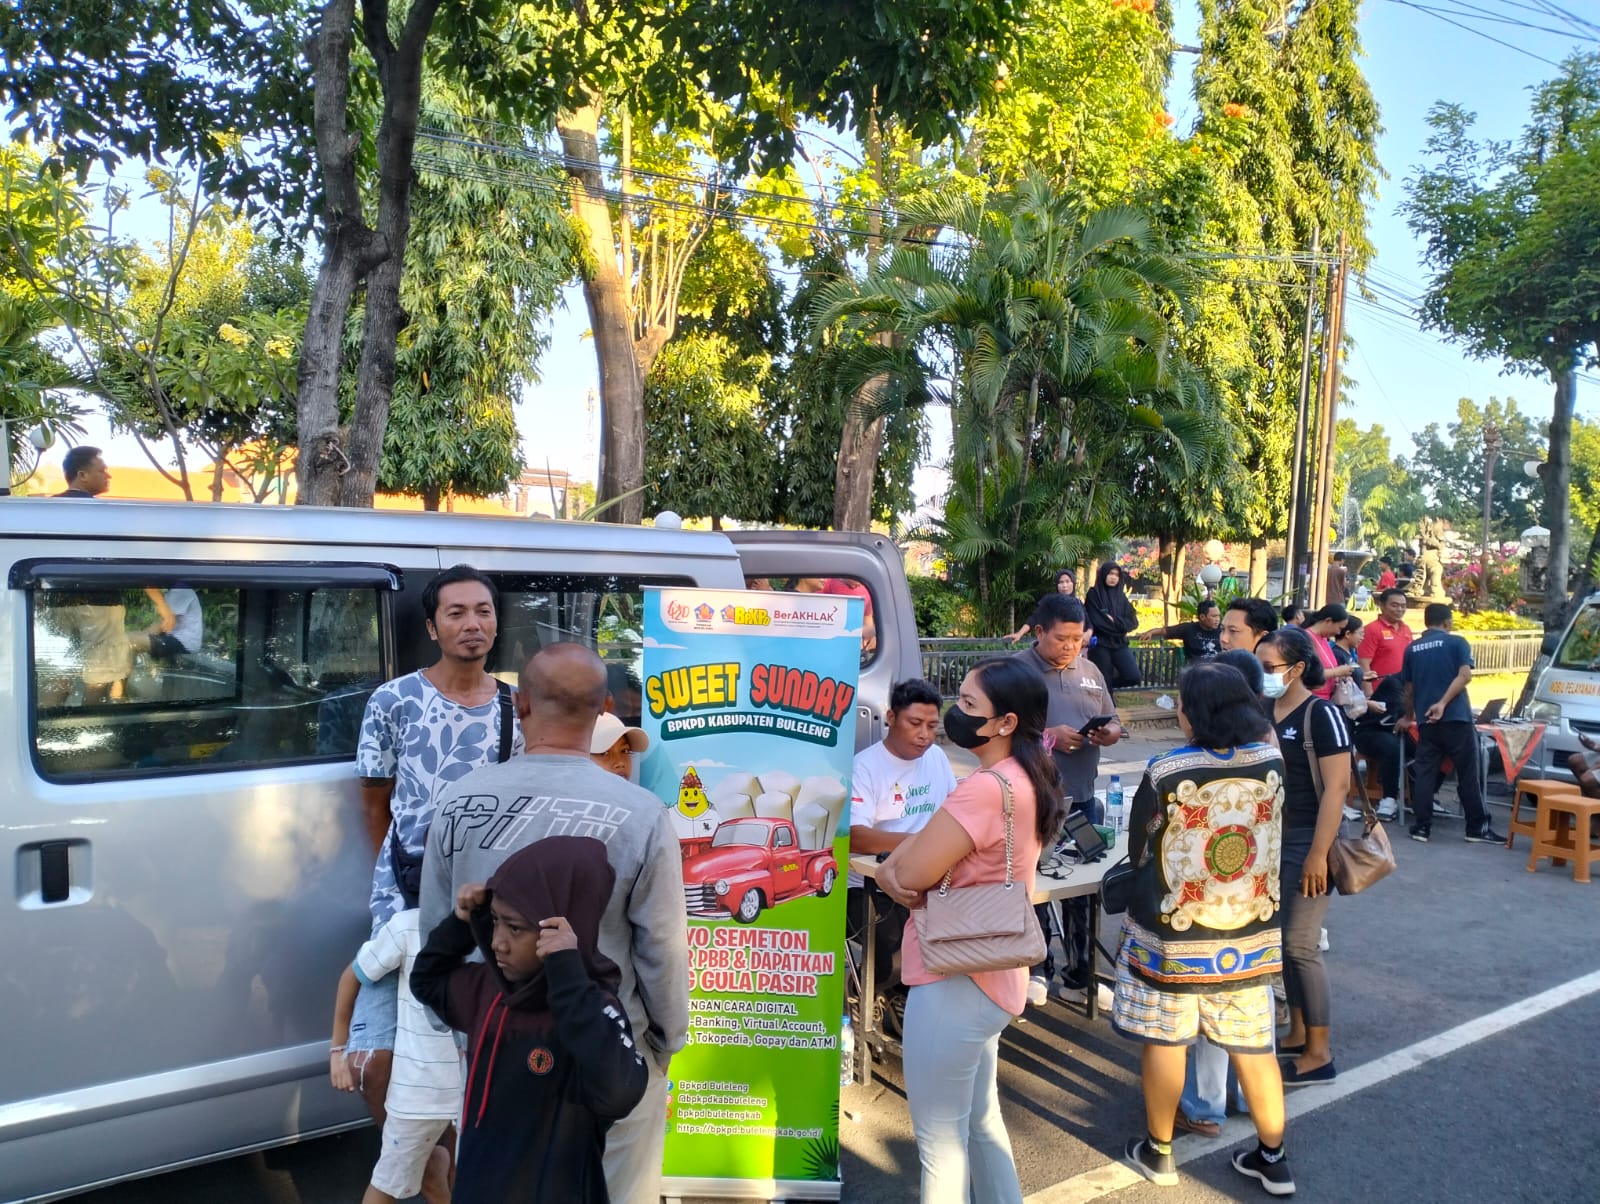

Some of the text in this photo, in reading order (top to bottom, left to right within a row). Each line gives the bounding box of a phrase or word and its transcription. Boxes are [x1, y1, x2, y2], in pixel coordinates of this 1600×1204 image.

[774, 610, 834, 622] BerAKHLAK
[1412, 640, 1444, 652] SECURITY
[646, 662, 855, 723] SWEET SUNDAY
[667, 715, 831, 739] BPKPD KABUPATEN BULELENG
[687, 927, 807, 950] YO SEMETON
[698, 949, 730, 968] PBB
[733, 950, 746, 969] &
[751, 951, 833, 973] DAPATKAN
[701, 970, 752, 991] GULA
[757, 973, 816, 995] PASIR
[724, 1001, 753, 1012] CARA
[756, 1004, 797, 1015] DIGITAL
[690, 1016, 826, 1034] -Banking, Virtual Account,
[696, 1032, 752, 1045] Tokopedia,
[755, 1035, 786, 1048] Gopay
[789, 1037, 807, 1047] dan
[810, 1037, 836, 1048] ATM)
[679, 1081, 748, 1092] Bpkpd Buleleng
